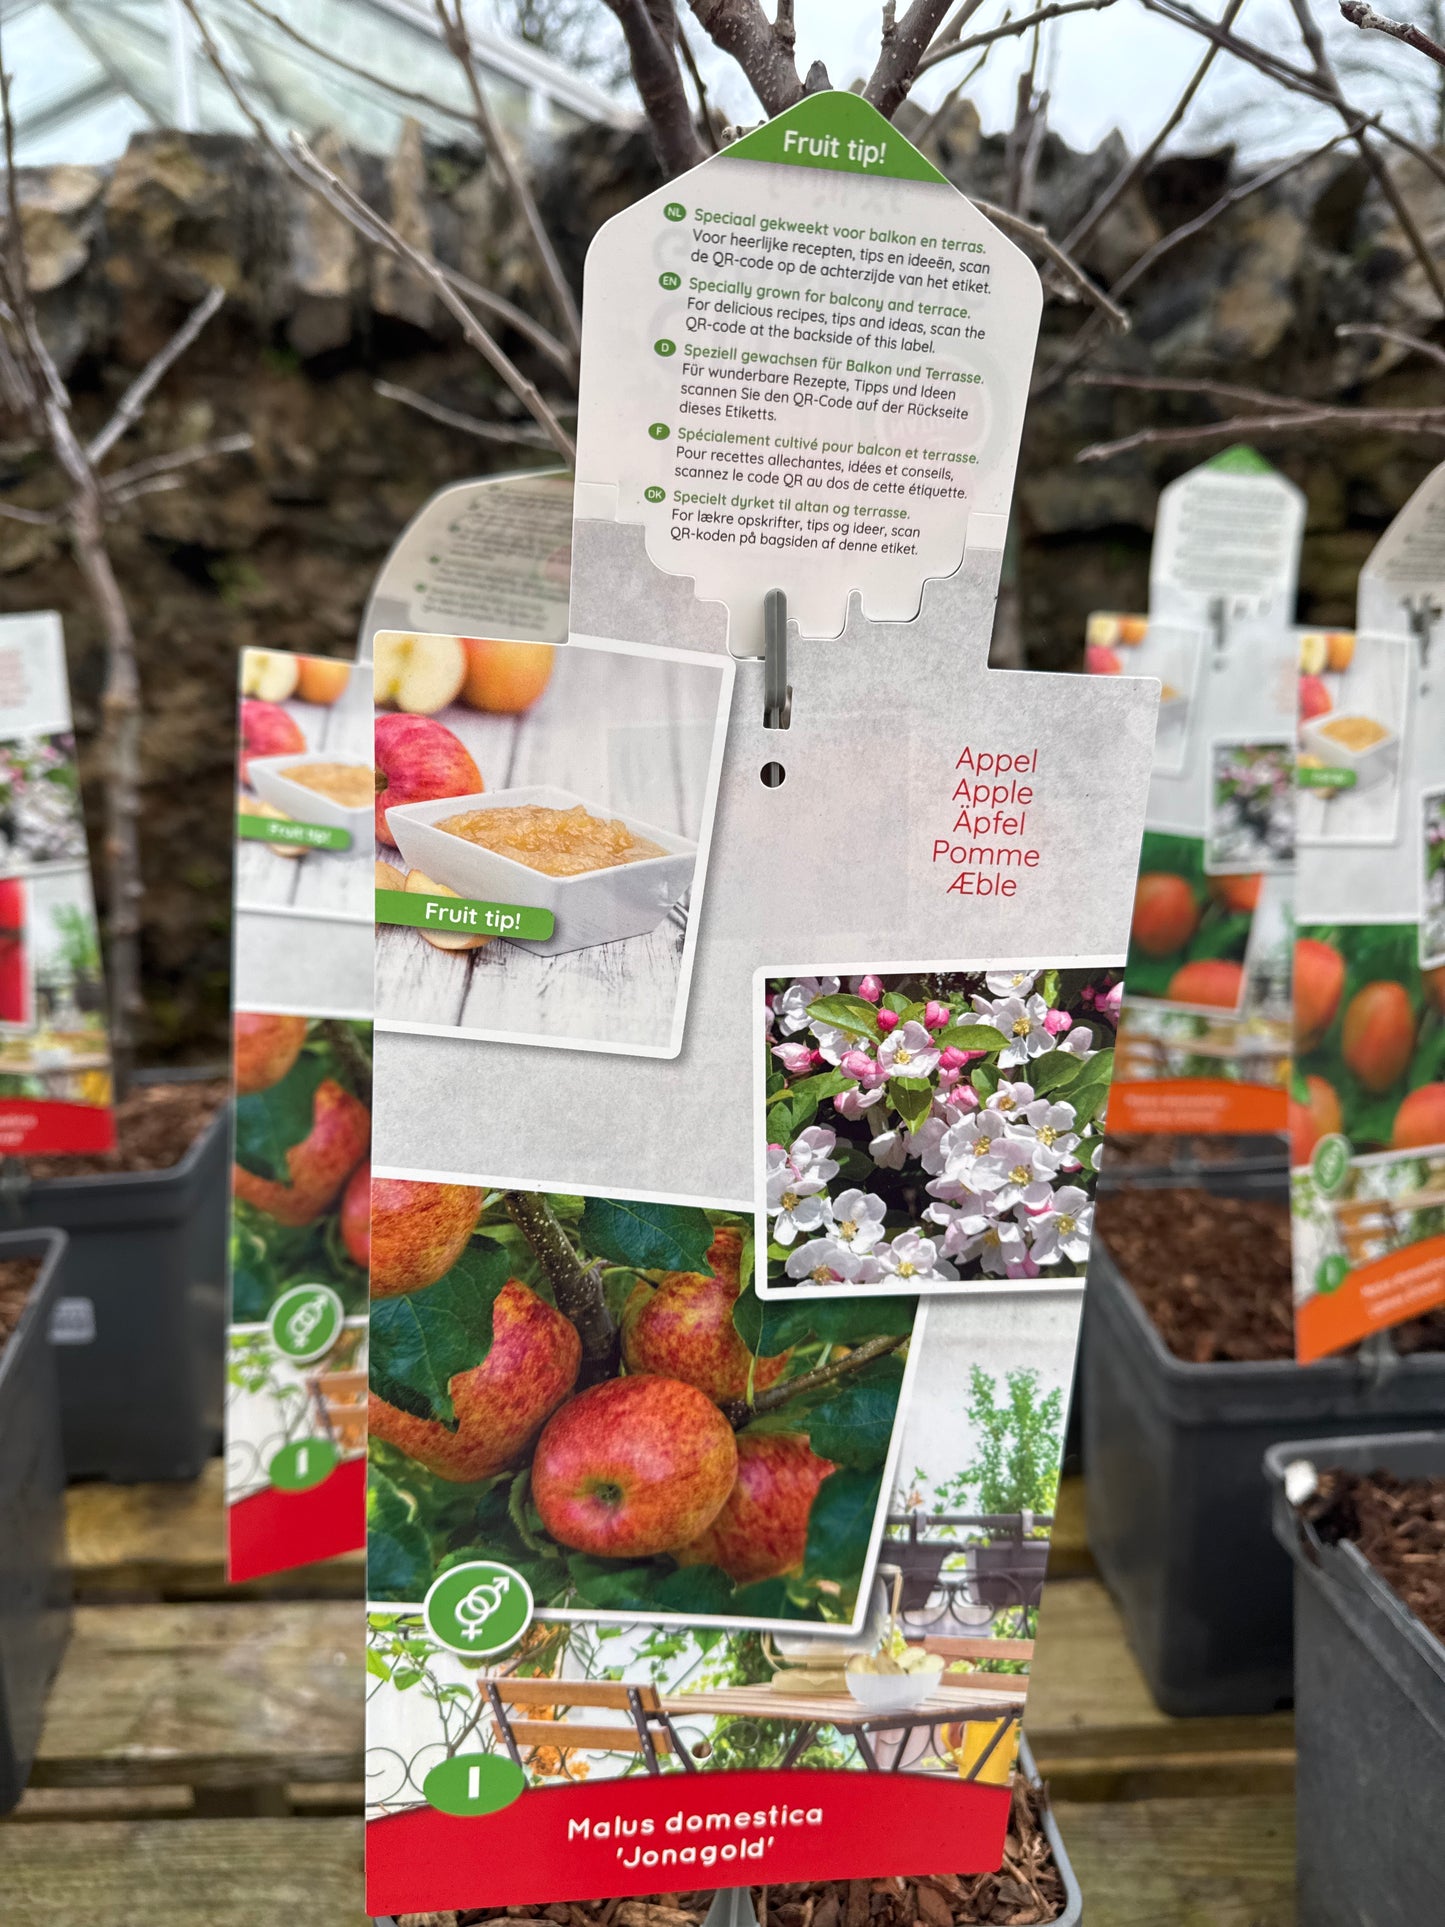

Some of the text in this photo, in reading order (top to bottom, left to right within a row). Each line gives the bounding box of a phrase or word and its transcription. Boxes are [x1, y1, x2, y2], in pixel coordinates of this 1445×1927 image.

[783, 129, 887, 168] Fruit tip!
[667, 206, 986, 254] NL Speciaal gekweekt voor balkon en terras.
[692, 228, 990, 275] Voor heerlijke recepten, tips en ideeën, scan
[690, 248, 991, 294] de QR-code op de achterzijde van het etiket.
[662, 275, 971, 319] EN Specially grown for balcony and terrace.
[685, 316, 935, 354] QR-code at the backside of this label.
[687, 296, 986, 340] For delicious recipes, tips and ideas, scan the
[661, 342, 984, 384] D Speziell gewachsen für Balkon und Terrasse.
[682, 362, 956, 401] Für wunderbare Rezepte, Tipps und Ideen
[679, 400, 777, 421] dieses Etiketts.
[680, 384, 969, 420] scannen Sie den QR-Code auf der Rückseite
[656, 426, 979, 464] F Spécialement cultivé pour balcon et terrasse.
[676, 445, 954, 482] Pour recettes allechantes, idées et conseils,
[674, 466, 967, 499] scannez le code QR au dos de cette étiquette.
[648, 489, 910, 520] DK Specielt dyrket til altan og terrasse.
[670, 526, 918, 555] QR-koden på bagsiden af denne etiket.
[672, 508, 920, 538] For lækre opskrifter, tips og ideer, scan
[955, 746, 1038, 778] Appel
[952, 778, 1033, 809] Apple
[952, 804, 1026, 840] Äpfel
[933, 839, 1040, 868] Pomme
[946, 871, 1017, 897] Æble
[425, 902, 521, 933] Fruit tip!
[567, 1804, 824, 1842] Malus domestica
[615, 1835, 776, 1869] 'Jonagold'
